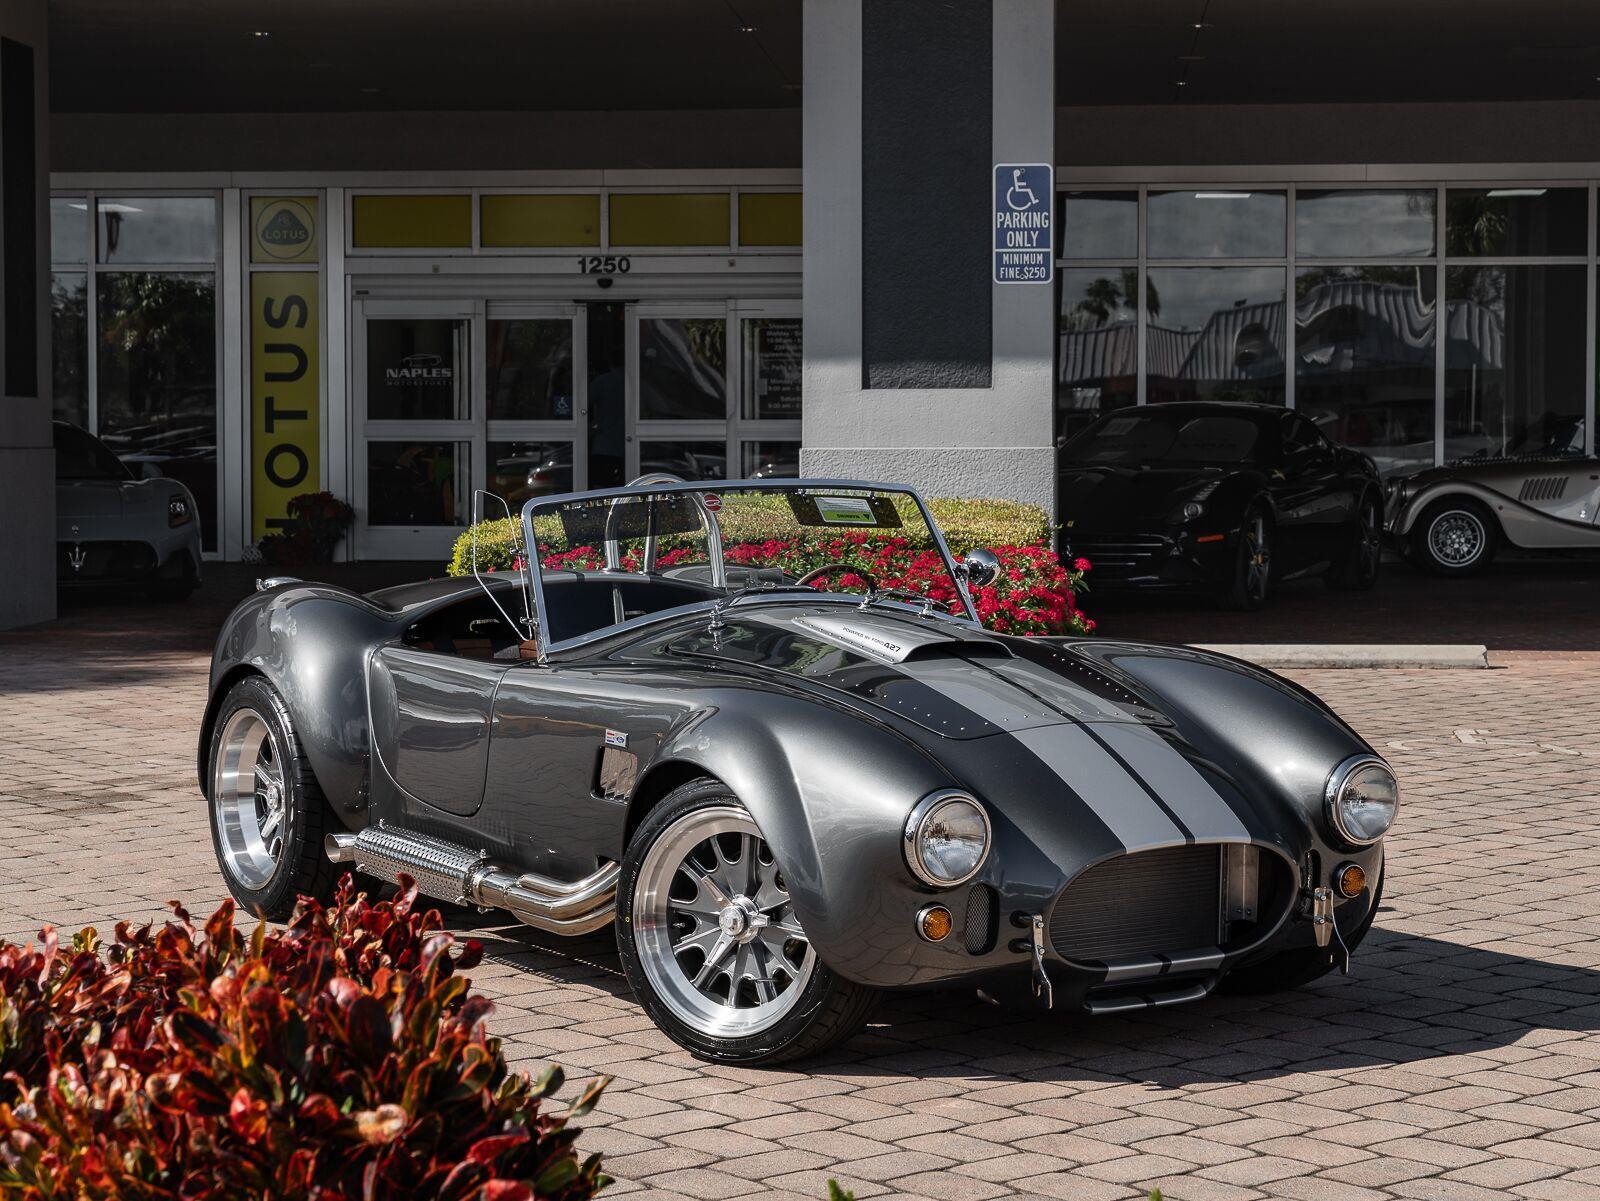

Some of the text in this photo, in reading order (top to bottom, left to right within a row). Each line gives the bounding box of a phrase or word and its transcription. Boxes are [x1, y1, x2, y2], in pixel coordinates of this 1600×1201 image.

[997, 212, 1049, 228] PARKING
[266, 230, 305, 240] LOTUS
[1006, 231, 1039, 247] ONLY
[578, 256, 631, 274] 1250
[1003, 253, 1043, 265] MINIMUM
[1000, 267, 1046, 279] FINE $250
[386, 368, 452, 378] NAPLES
[883, 642, 902, 653] 427
